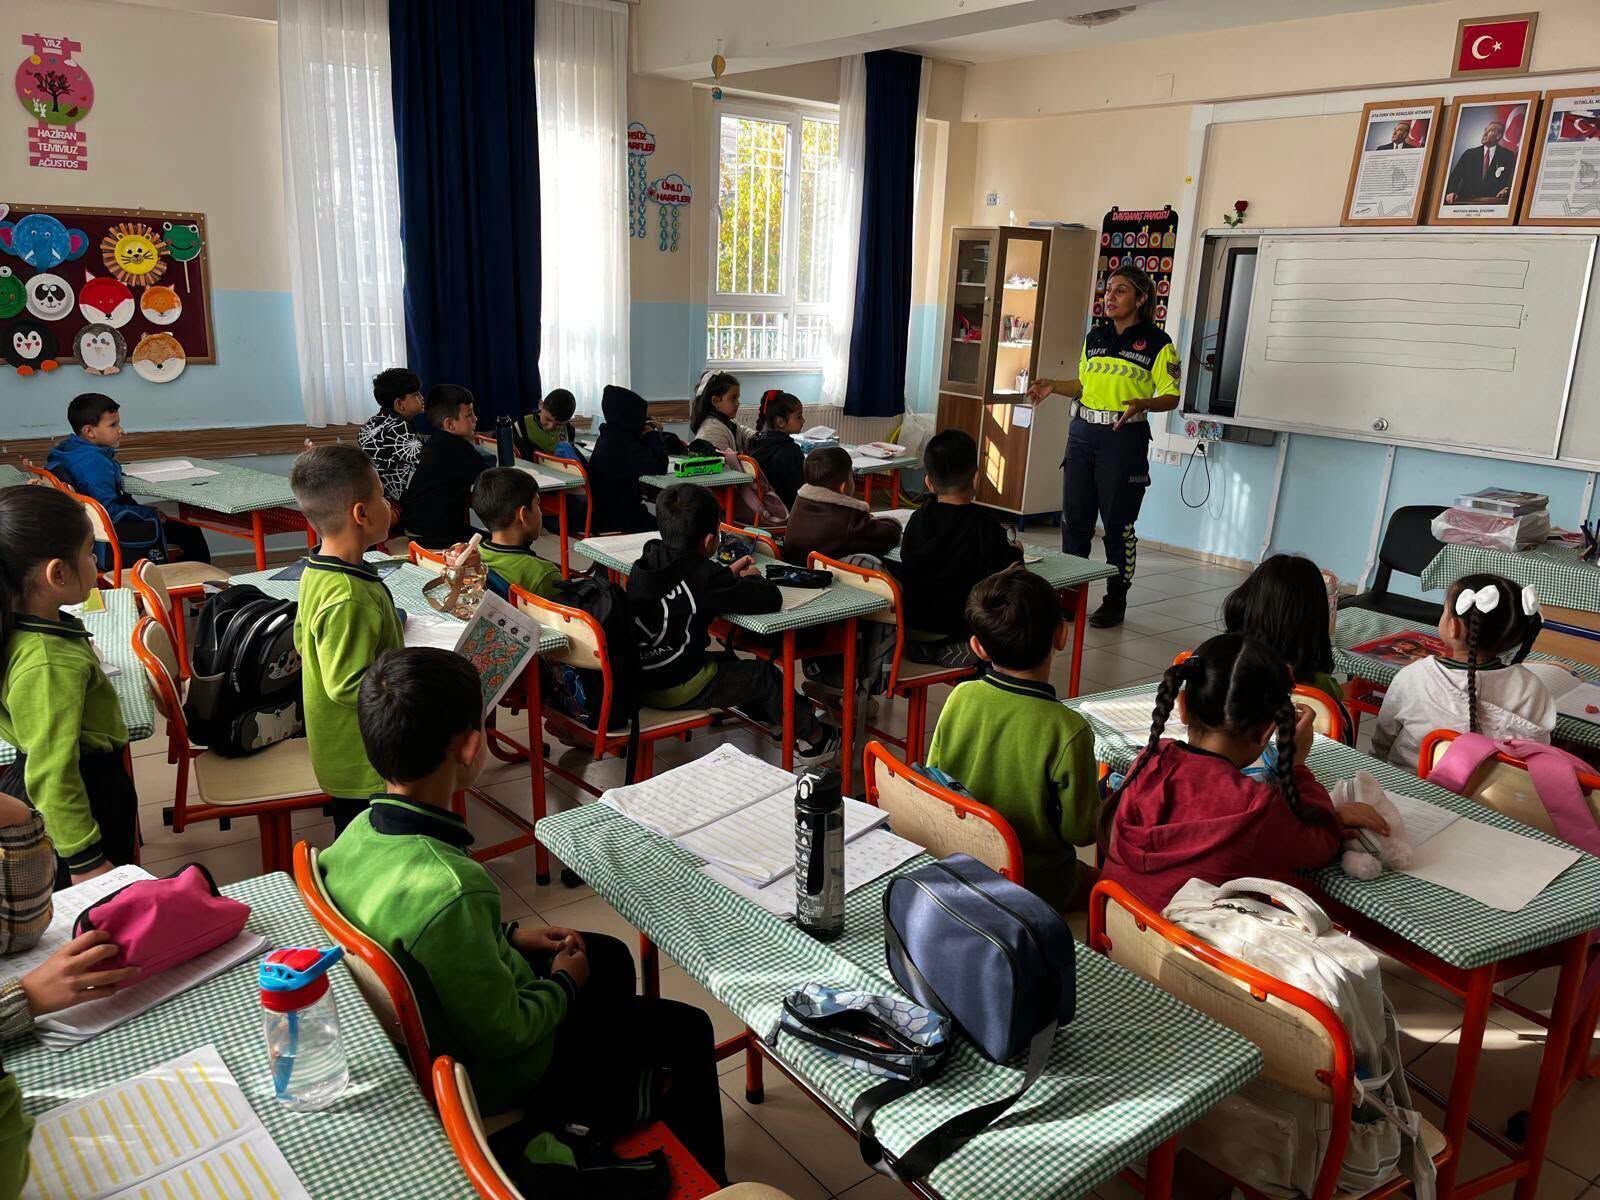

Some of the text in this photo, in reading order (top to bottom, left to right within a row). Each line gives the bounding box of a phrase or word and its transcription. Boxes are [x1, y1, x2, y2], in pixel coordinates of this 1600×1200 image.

[43, 39, 62, 48] YAZ
[37, 129, 77, 141] HAZİRAN
[628, 131, 646, 140] NSÜZ
[37, 143, 79, 155] TEMMUZ
[628, 142, 656, 152] ARFLER
[38, 158, 79, 169] AĞUSTOS
[661, 181, 683, 192] ÜNLÜ
[656, 193, 691, 204] HARFLER
